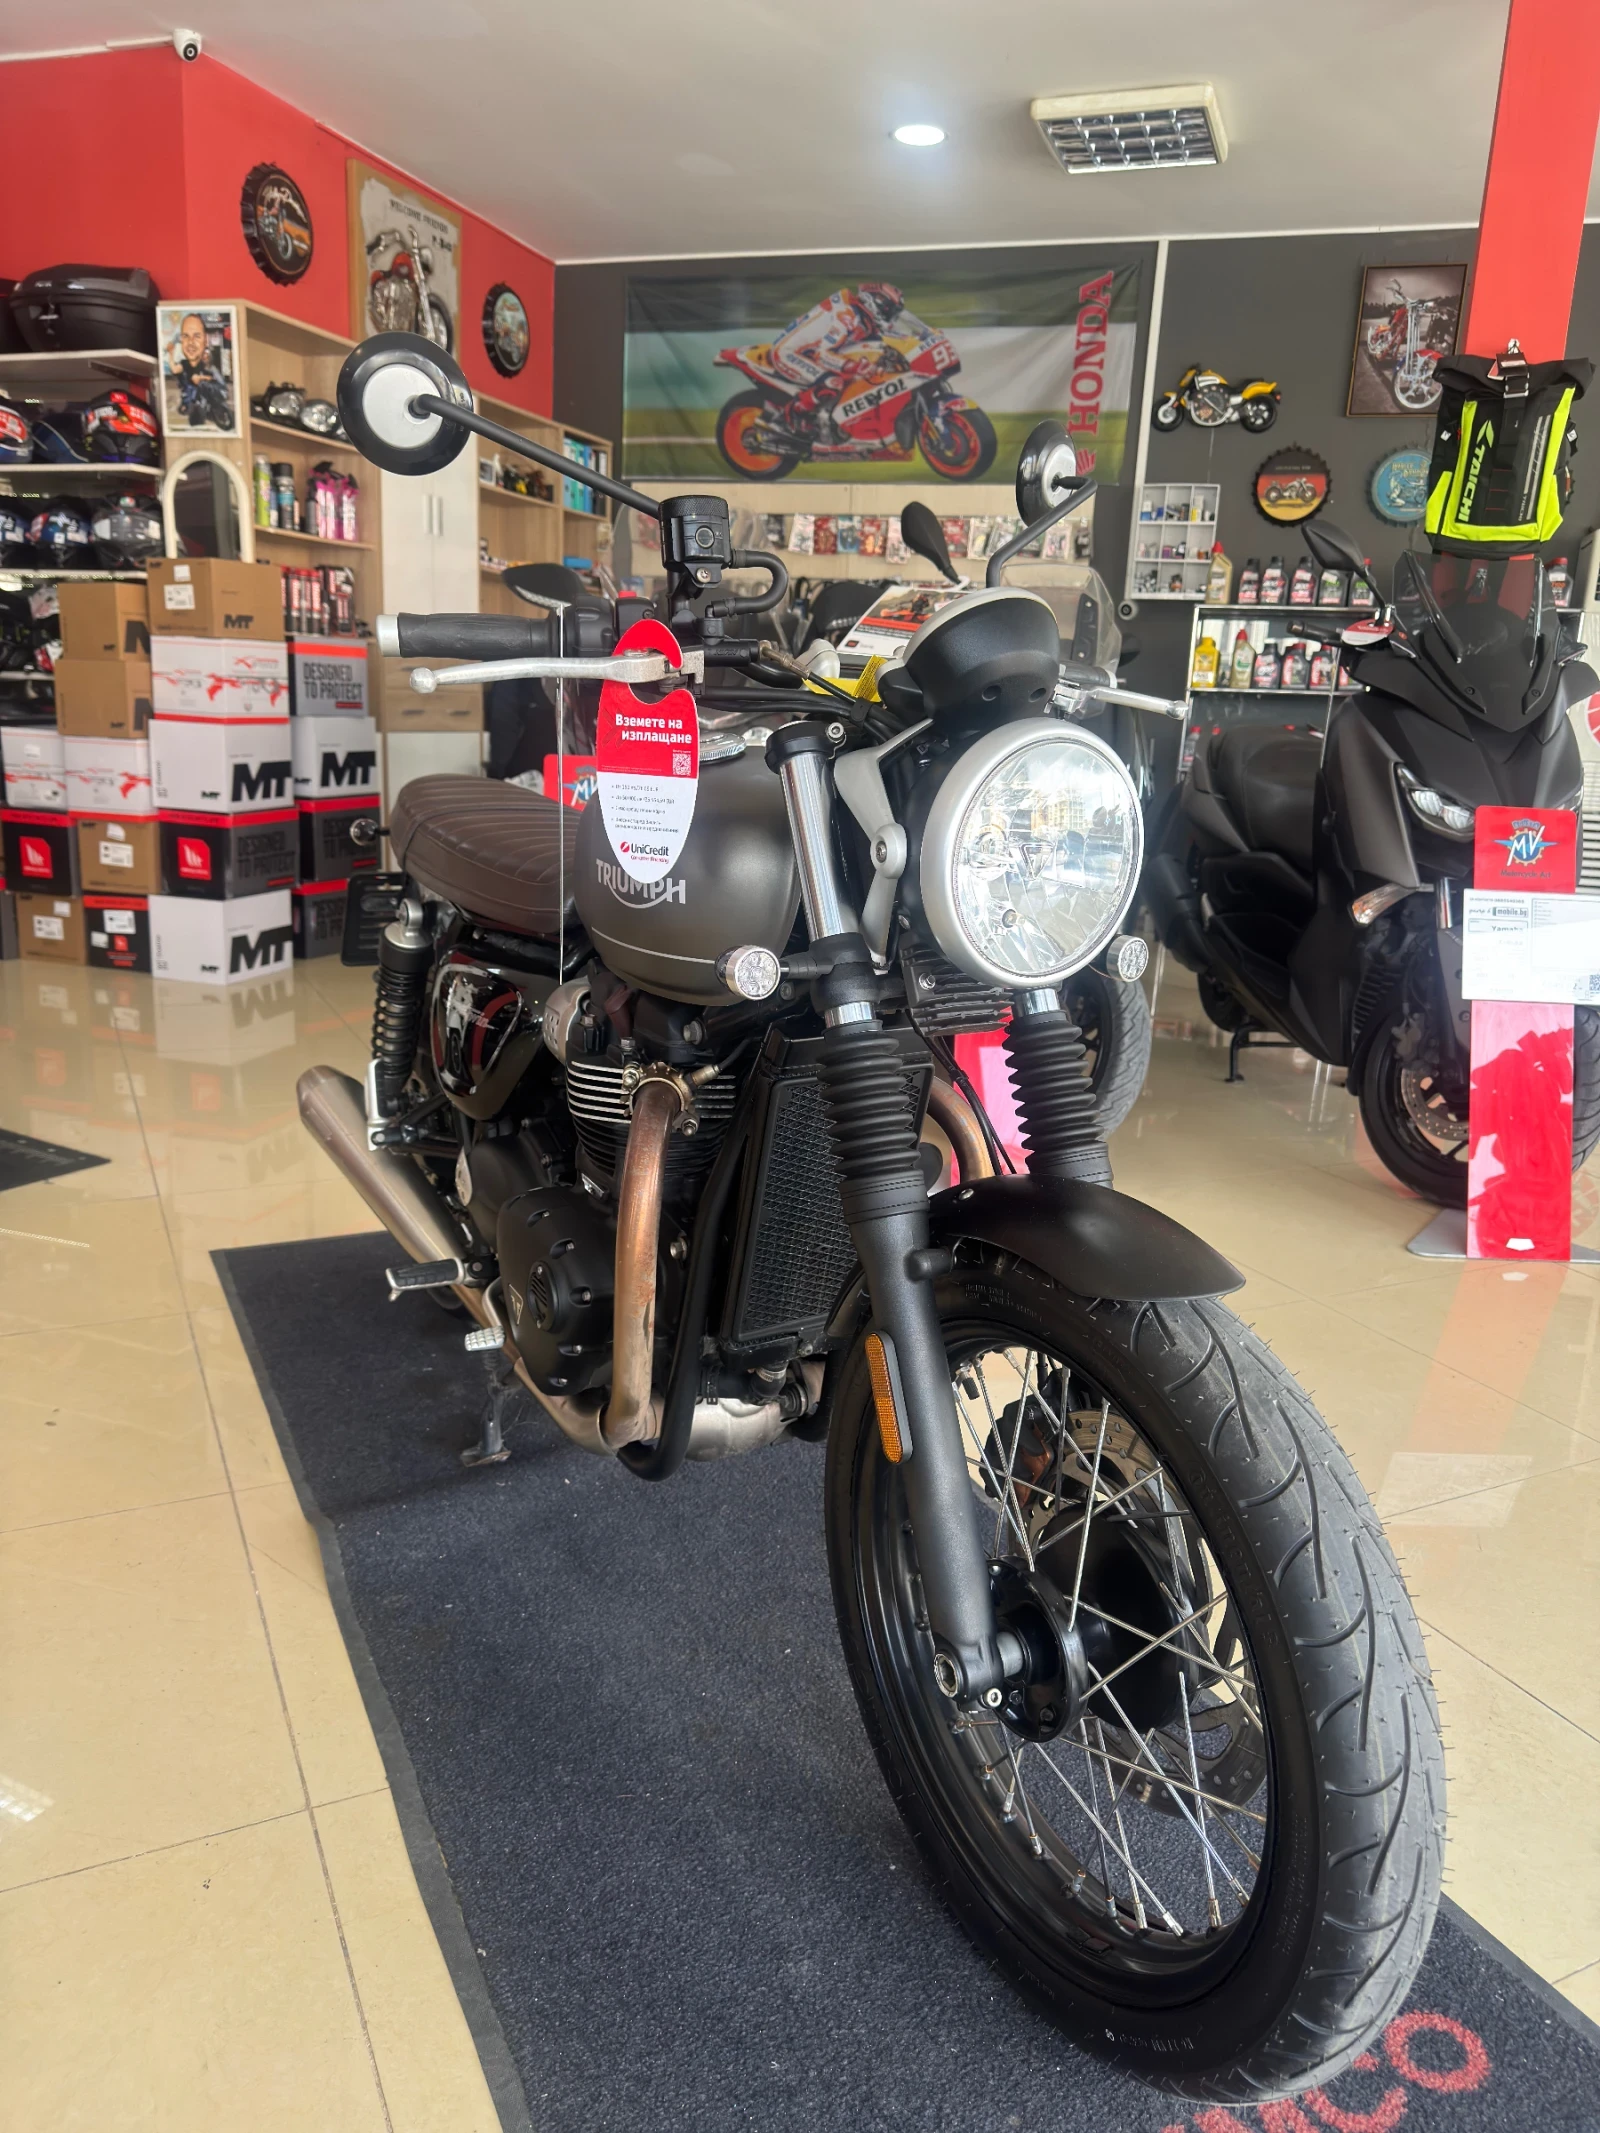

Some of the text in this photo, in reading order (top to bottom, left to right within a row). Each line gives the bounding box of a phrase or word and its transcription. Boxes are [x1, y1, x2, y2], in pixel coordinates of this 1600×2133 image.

[1067, 270, 1114, 436] HONDA
[1458, 444, 1486, 523] TAICHI
[224, 614, 254, 630] MT
[303, 662, 353, 682] DESIGNED
[305, 681, 363, 701] TO PROTECT
[615, 714, 683, 730] Вземете на
[621, 730, 693, 746] изплащане
[321, 751, 376, 787] MT
[231, 761, 292, 802] MT
[200, 790, 220, 800] MT
[631, 843, 670, 857] UniCredit
[1506, 825, 1545, 867] MV
[595, 859, 687, 906] TRIUMPH
[1500, 869, 1551, 879] Motorcycle Art
[1497, 908, 1528, 917] mobile.bg
[229, 925, 293, 974] MT
[200, 964, 219, 974] MT
